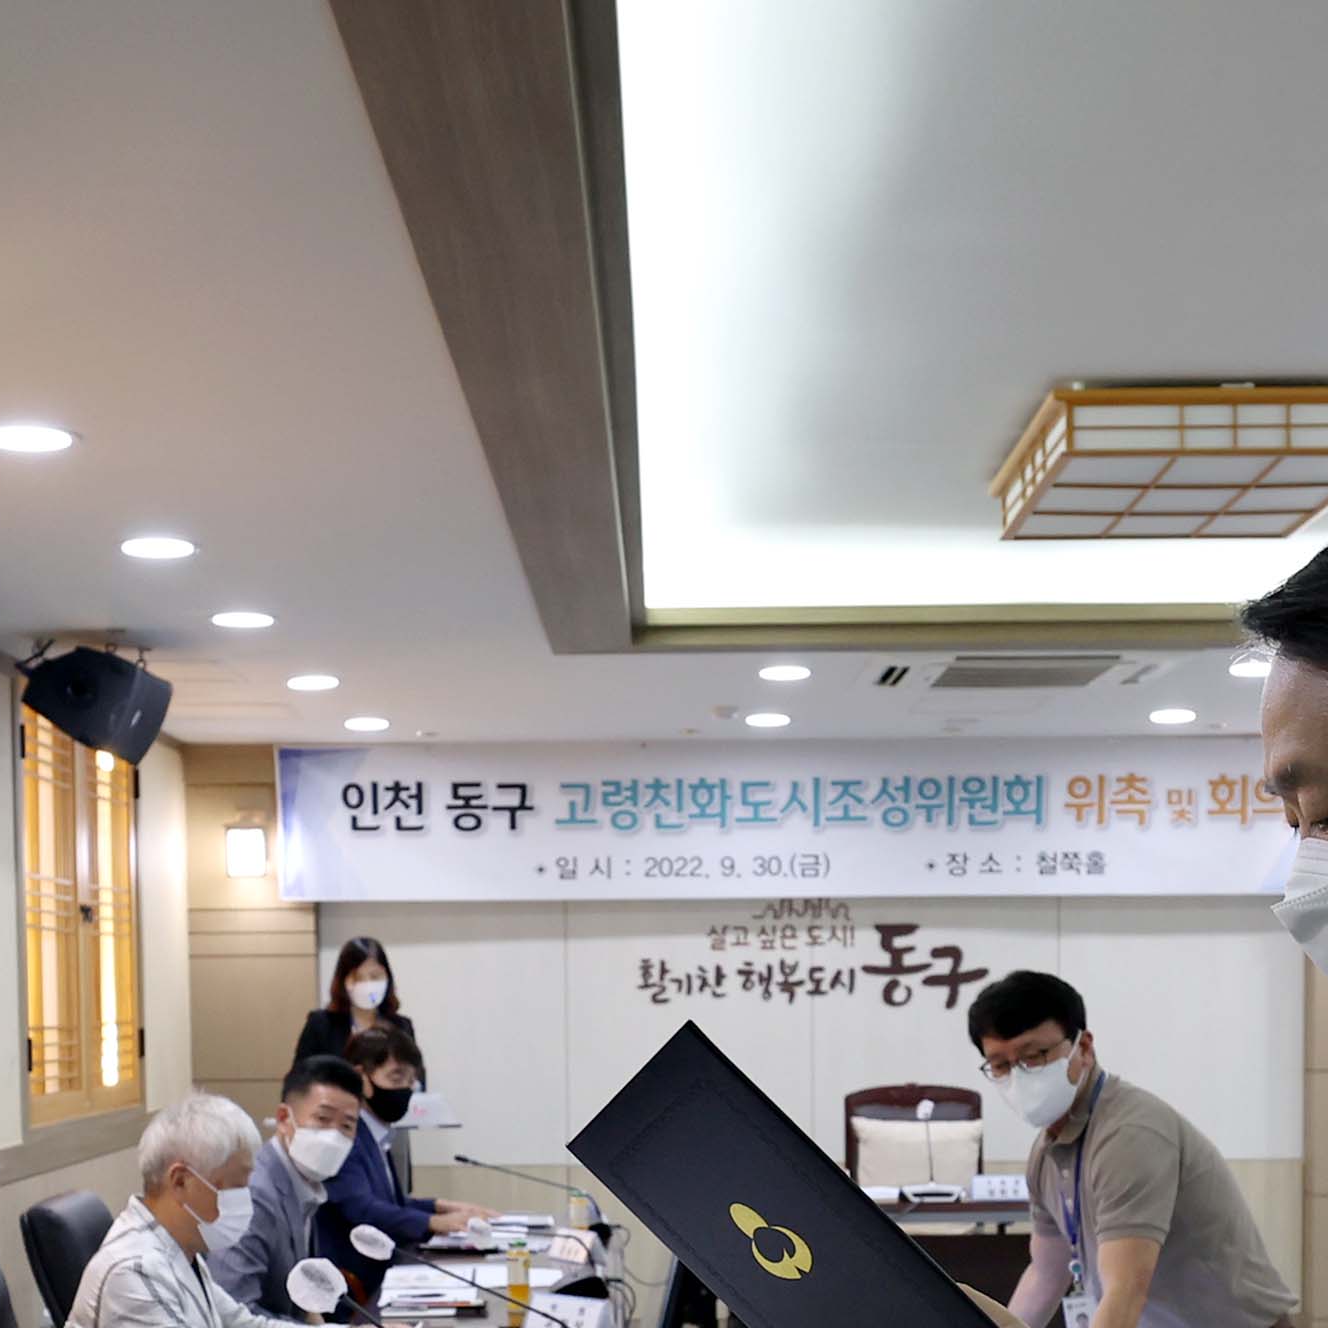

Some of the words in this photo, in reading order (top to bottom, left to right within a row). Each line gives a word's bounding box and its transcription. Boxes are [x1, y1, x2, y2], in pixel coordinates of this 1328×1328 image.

[341, 780, 426, 832] 인천
[445, 780, 536, 832] 동구
[554, 775, 1044, 831] 고령친화도시조성위원회
[1063, 773, 1153, 827] 위촉
[1166, 786, 1197, 825] 및
[555, 855, 579, 881] 일
[588, 855, 613, 881] 시
[643, 856, 711, 879] 2022.
[720, 856, 742, 879] 9.
[752, 852, 832, 880] 30.(금)
[945, 852, 969, 878] 장
[978, 852, 1004, 876] 소
[1036, 851, 1108, 877] 철쭉홀
[706, 924, 751, 951] 살고
[756, 924, 799, 951] 싶은
[805, 924, 856, 949] 도시!
[636, 957, 727, 1004] 활기찬
[736, 957, 856, 1005] 행복도시
[860, 922, 990, 1010] 동구
